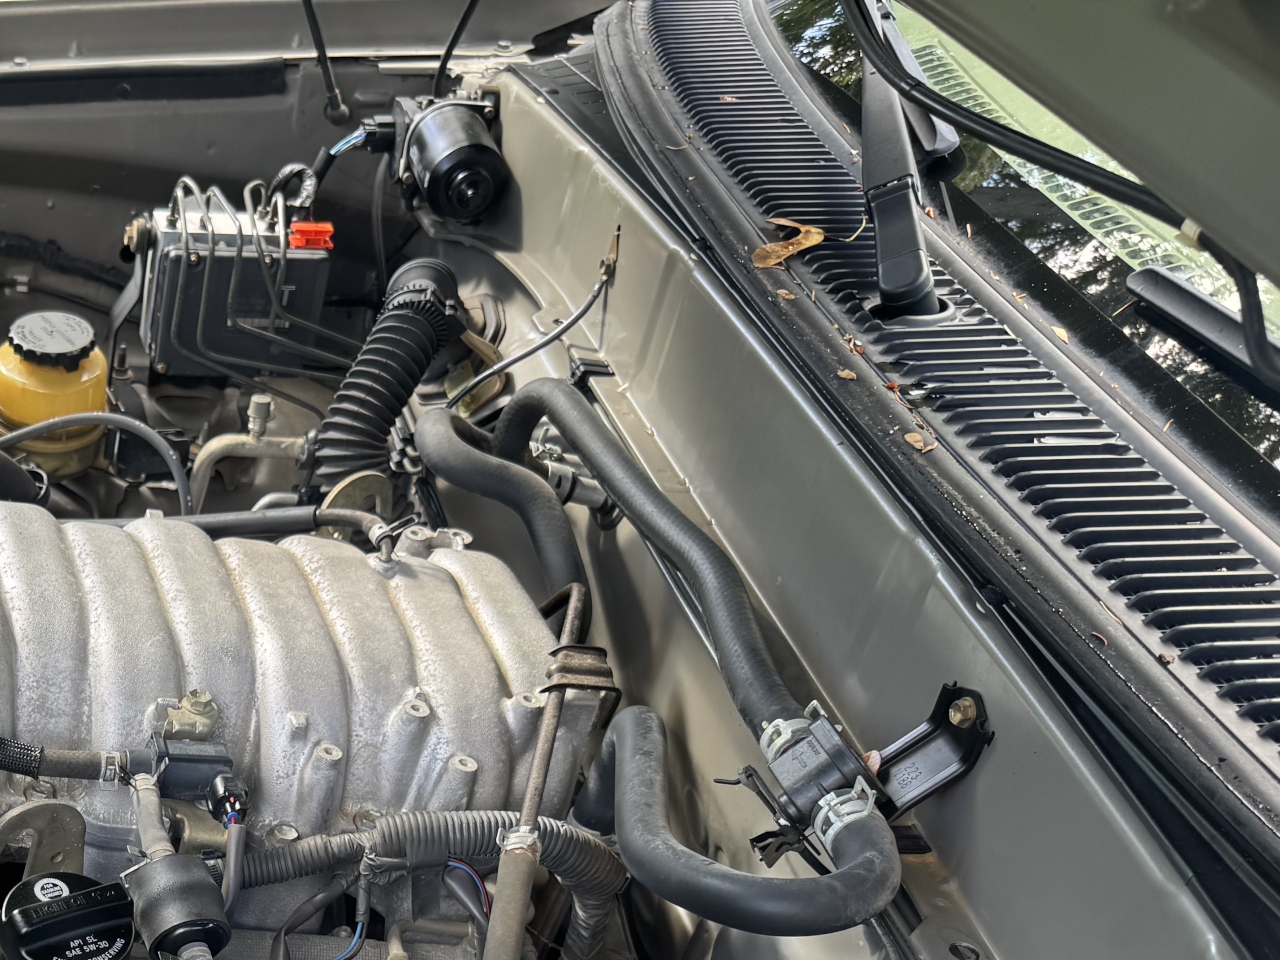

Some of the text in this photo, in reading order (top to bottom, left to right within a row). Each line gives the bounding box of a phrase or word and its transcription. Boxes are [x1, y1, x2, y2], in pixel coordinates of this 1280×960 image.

[65, 940, 109, 958] SAE 5W-30
[70, 934, 98, 948] API SL
